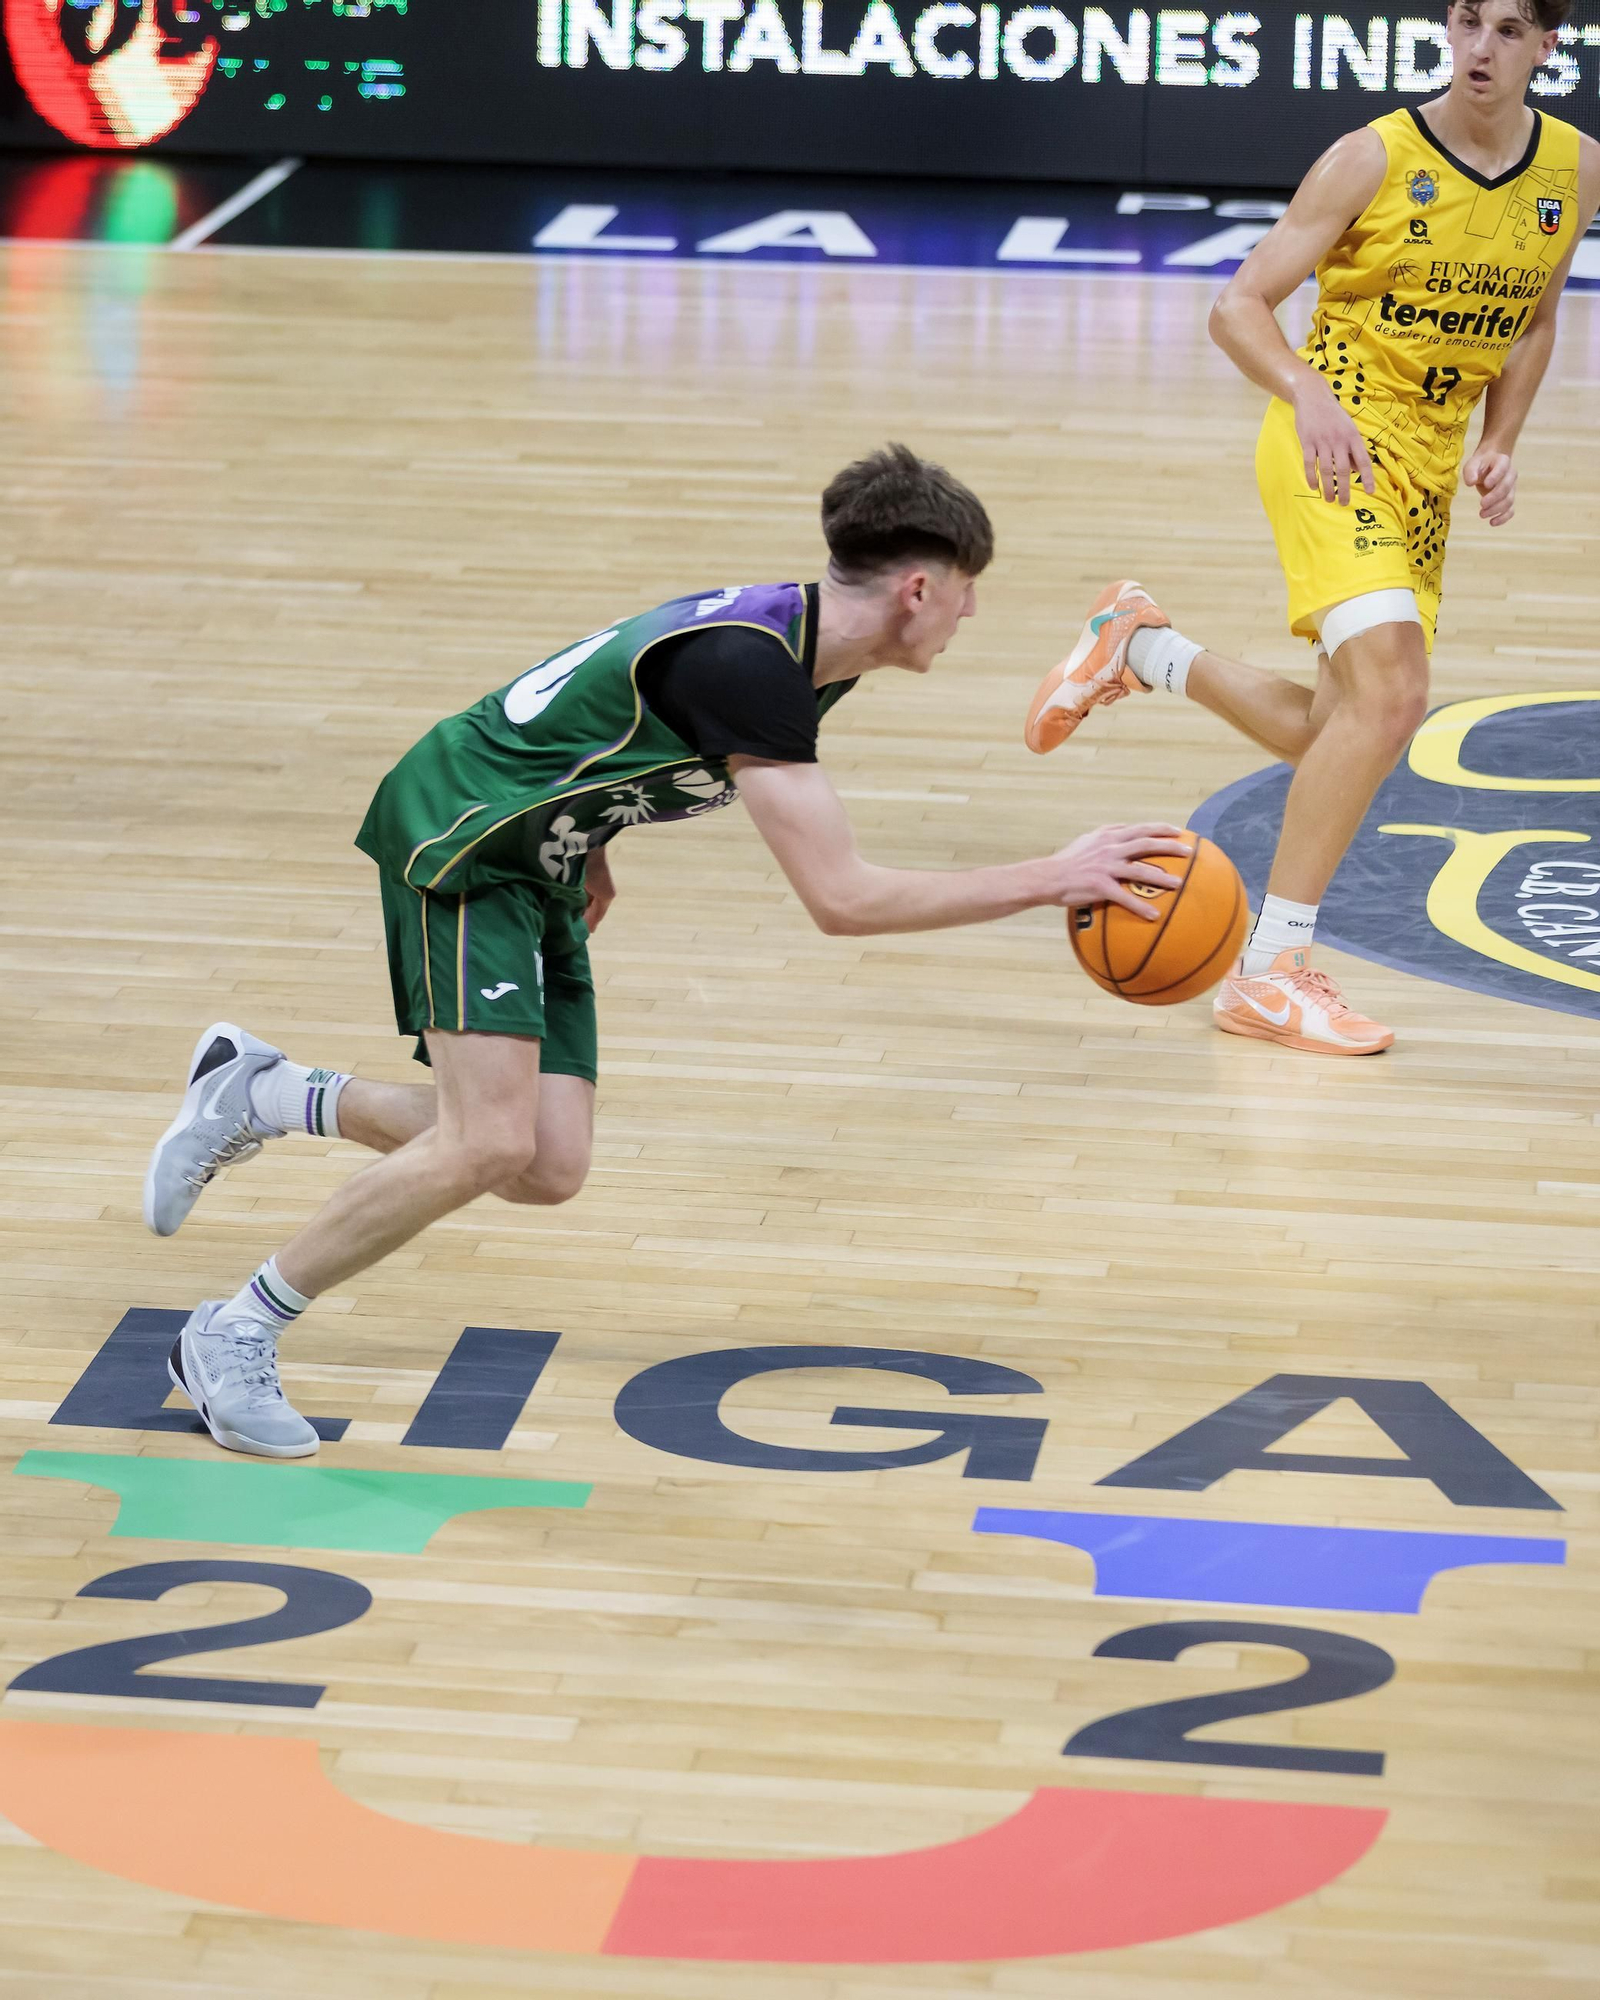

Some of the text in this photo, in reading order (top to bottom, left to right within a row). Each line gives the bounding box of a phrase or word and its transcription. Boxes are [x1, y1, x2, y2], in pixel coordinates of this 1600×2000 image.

[536, 0, 1262, 87] INSTALACIONES
[532, 203, 879, 258] LA
[1538, 199, 1561, 210] LIGA
[1425, 277, 1543, 300] CB CANARIAS
[1374, 322, 1441, 345] despierta
[1516, 903, 1600, 967] CAN
[48, 1307, 1567, 1512] LIGA
[6, 1560, 1397, 1776] 2 2
